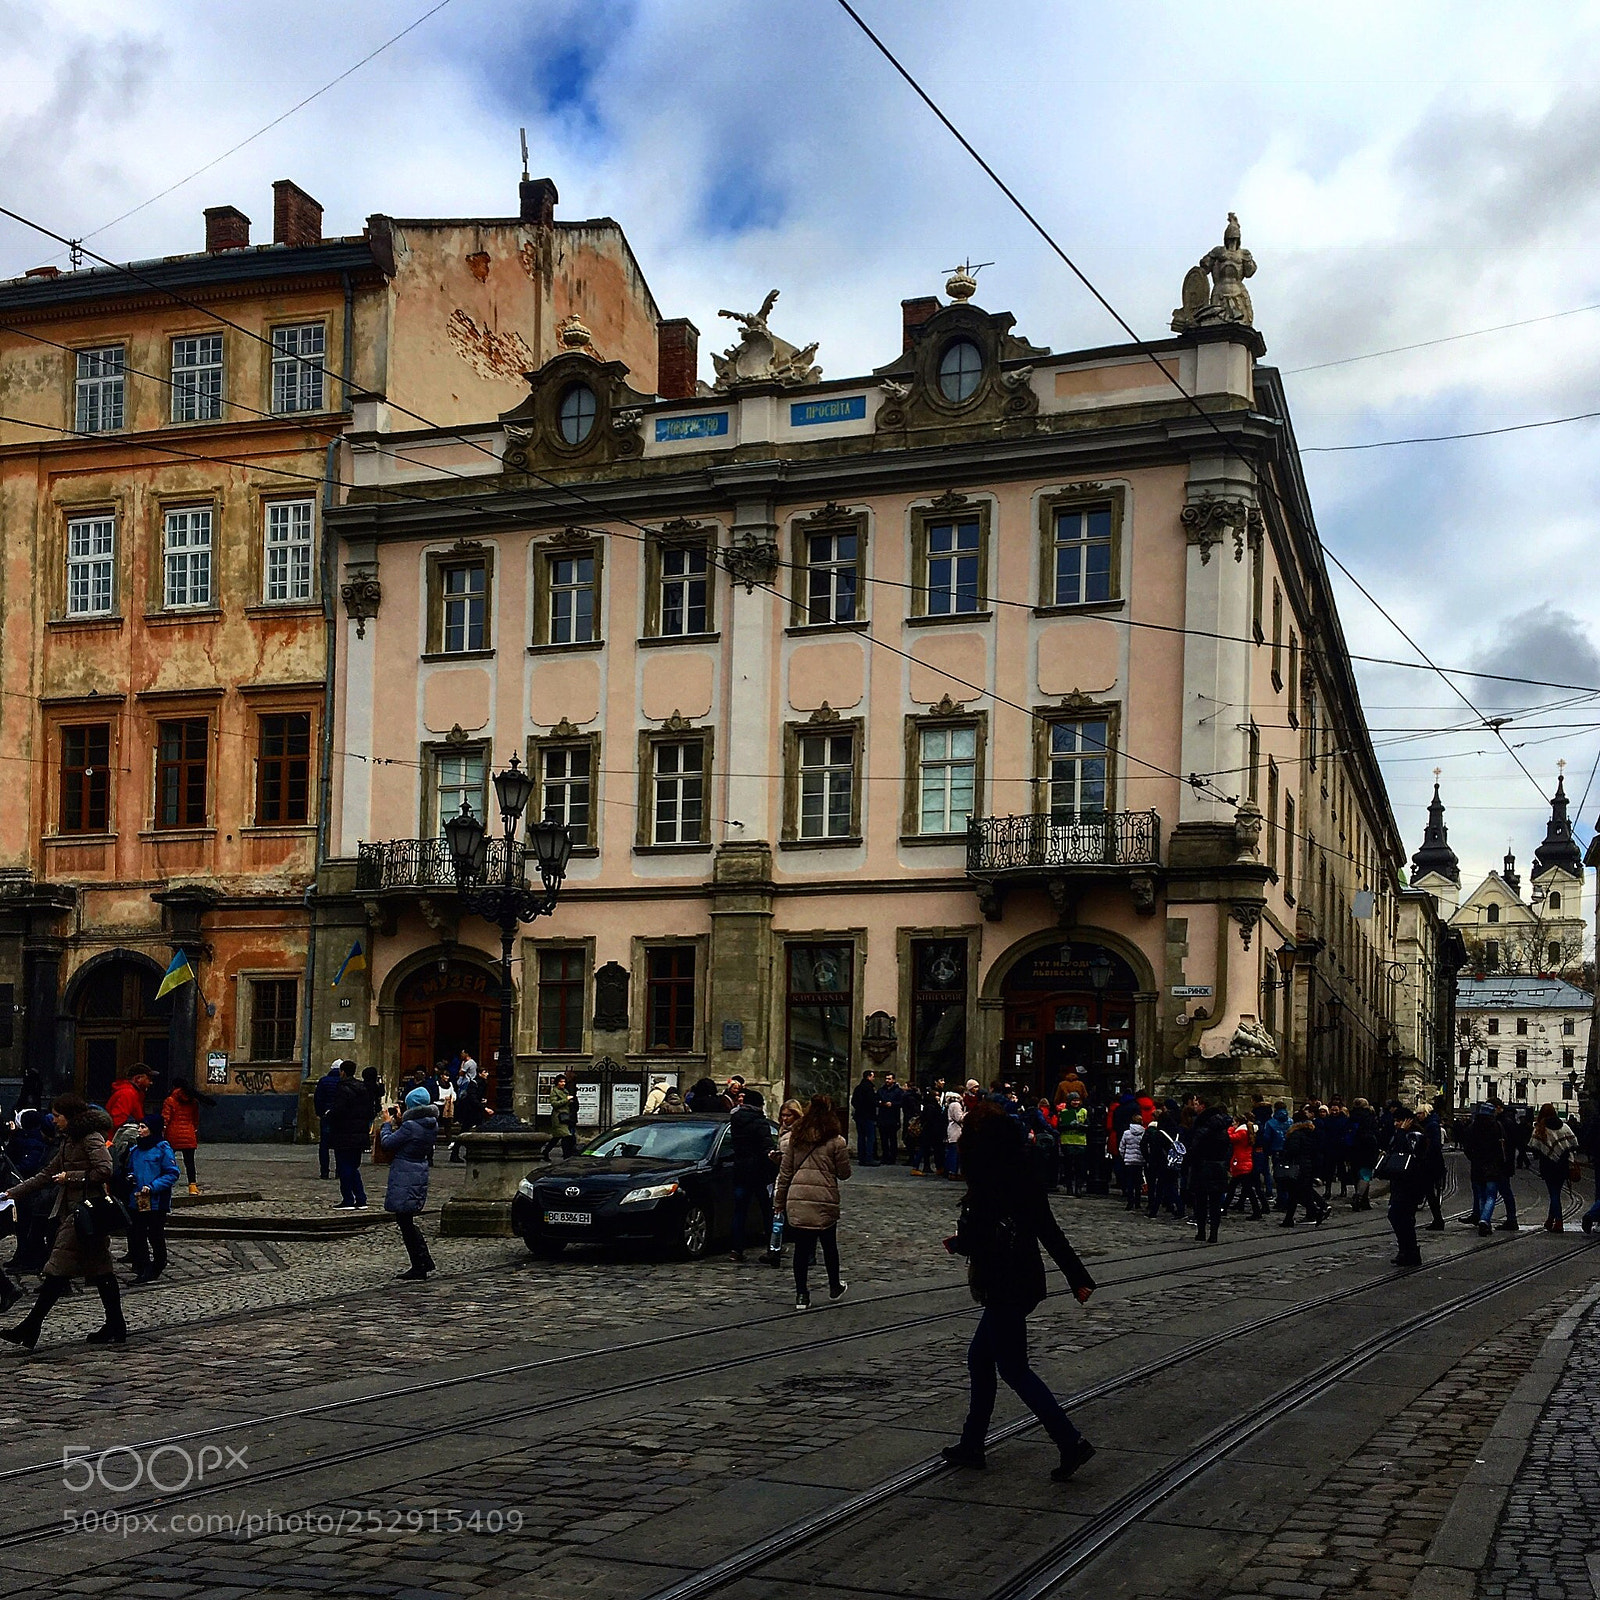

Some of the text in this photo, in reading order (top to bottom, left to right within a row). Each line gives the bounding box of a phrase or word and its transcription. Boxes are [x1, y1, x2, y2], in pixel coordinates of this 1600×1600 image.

[806, 401, 851, 419] ПРОСВІТА
[422, 974, 487, 995] МУЗЕЙ
[548, 1212, 590, 1223] BC 8386 EH
